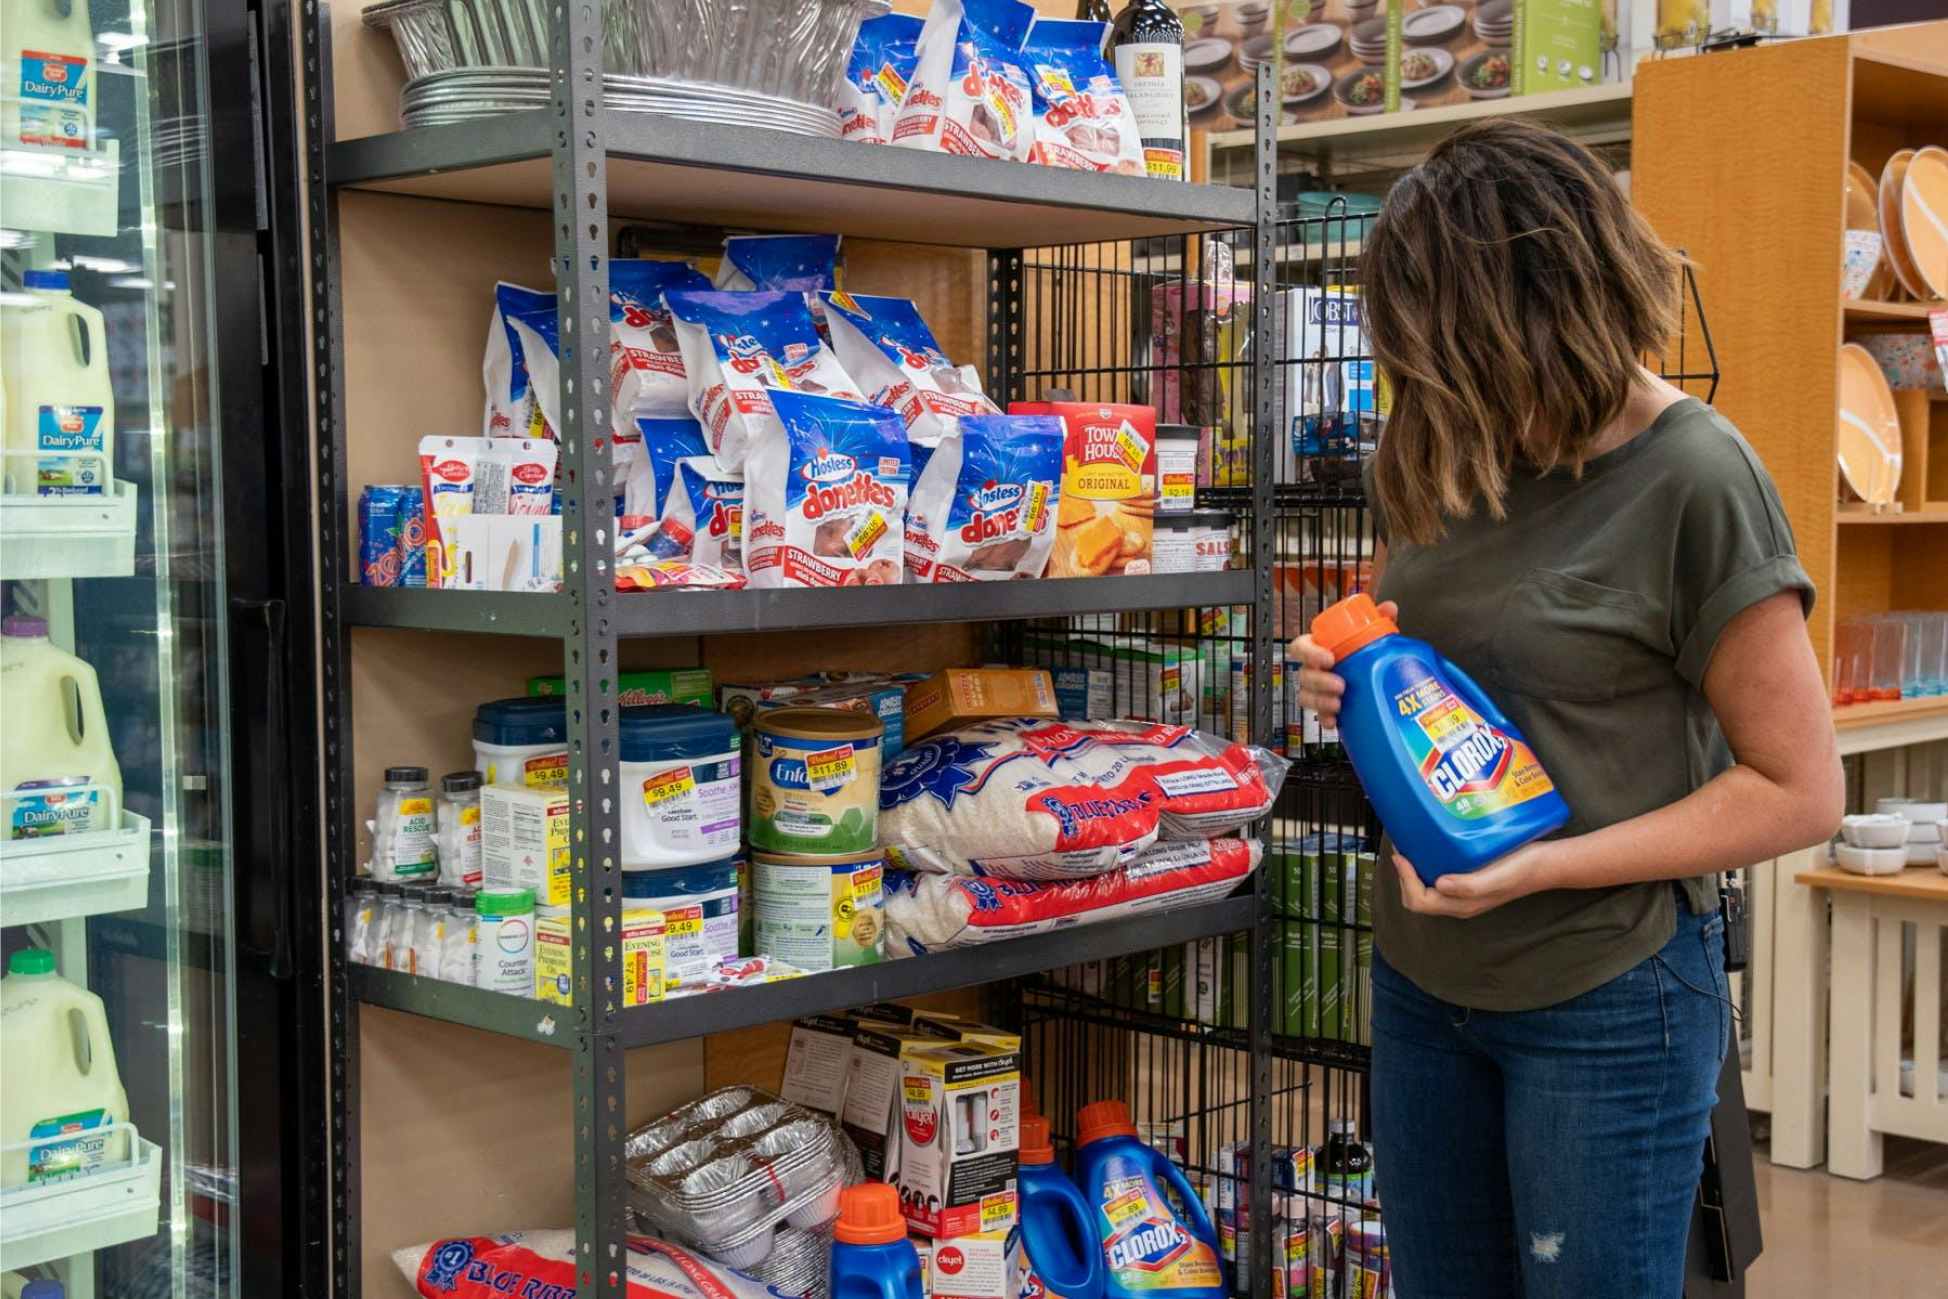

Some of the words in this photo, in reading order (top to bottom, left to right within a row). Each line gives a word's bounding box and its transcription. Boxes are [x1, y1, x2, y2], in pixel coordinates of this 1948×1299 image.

[24, 80, 84, 97] DairyPure
[42, 434, 100, 448] DairyPure
[1085, 444, 1120, 461] HOU
[810, 455, 852, 478] Hostess
[1078, 478, 1130, 489] ORIGINAL
[803, 473, 895, 520] donettes
[787, 551, 842, 579] STRAWBERRY
[1398, 695, 1421, 716] 4X
[535, 769, 564, 780] $9.49
[813, 761, 847, 775] $11.89
[653, 783, 682, 797] $9.49
[24, 807, 89, 823] DairyPure
[498, 959, 528, 968] Counter
[502, 968, 526, 976] Attack
